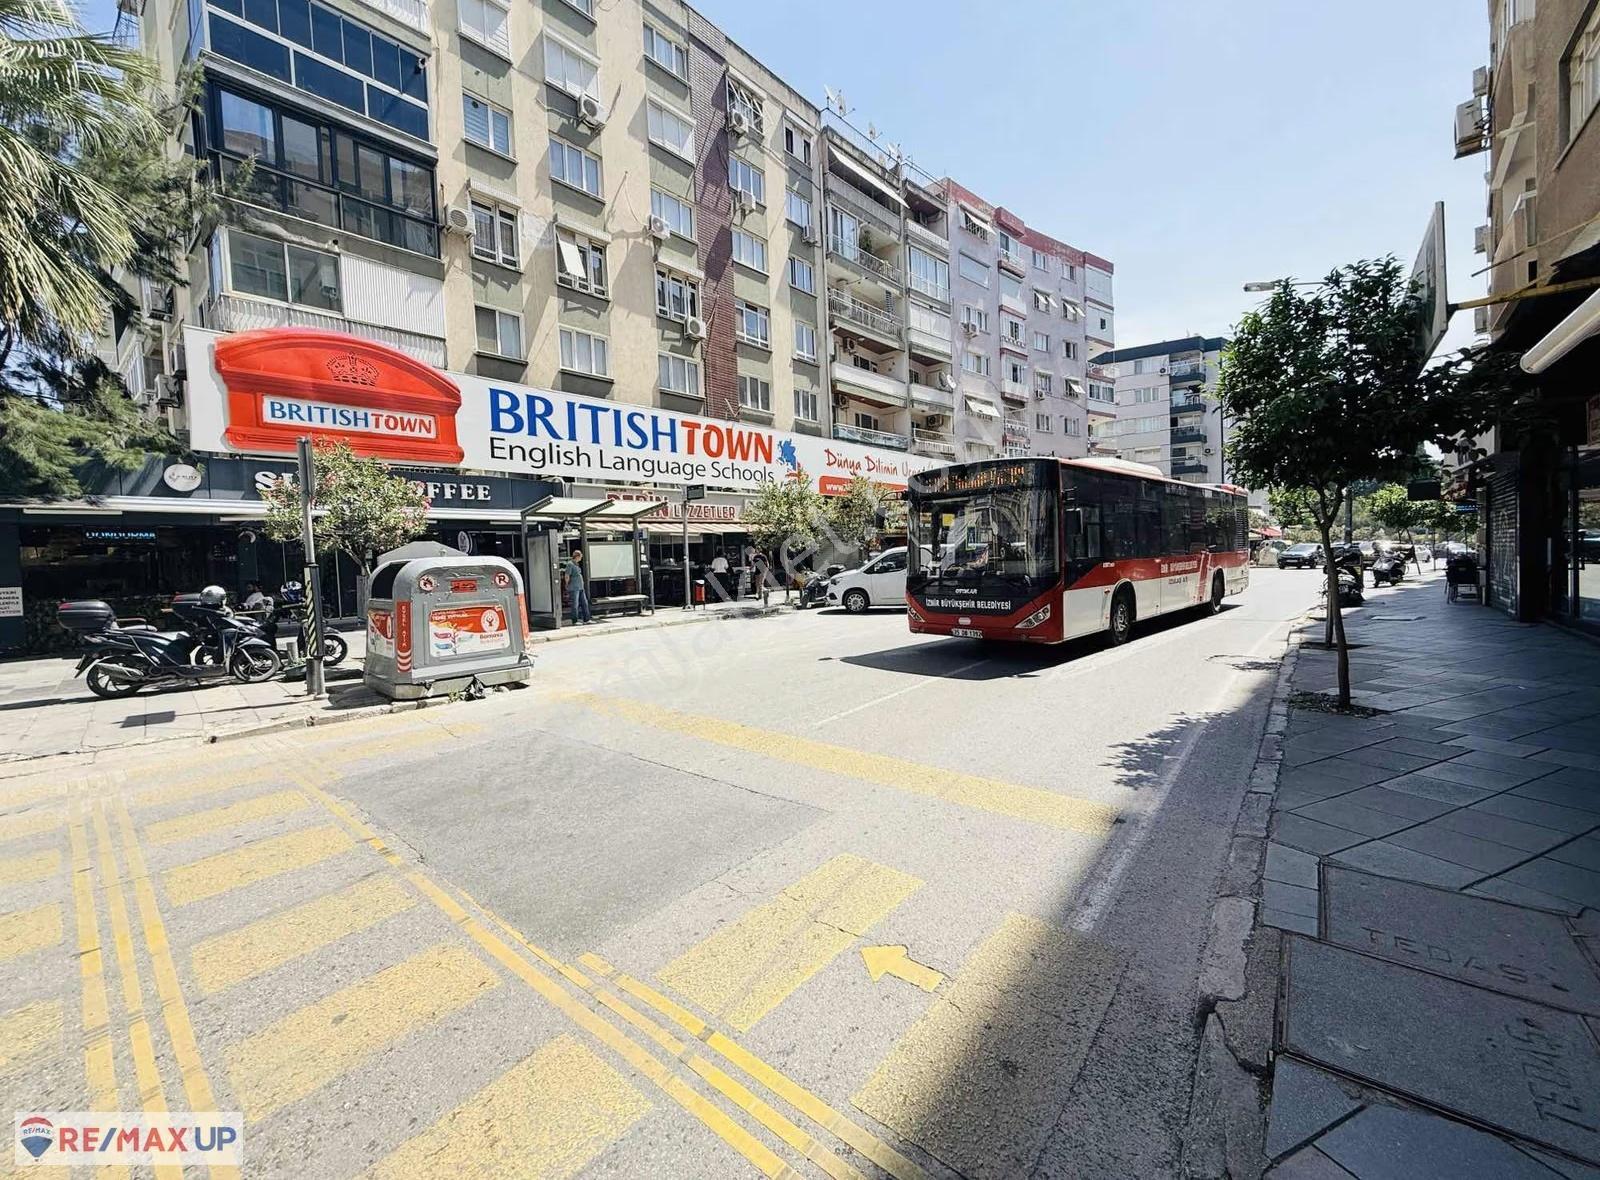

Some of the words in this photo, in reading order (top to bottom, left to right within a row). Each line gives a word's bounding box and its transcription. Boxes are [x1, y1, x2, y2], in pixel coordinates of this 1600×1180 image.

[269, 400, 433, 438] BRITISHTOWN
[488, 387, 774, 464] BRITISHTOWN
[489, 436, 592, 470] English
[599, 446, 707, 483] Language
[710, 460, 775, 484] Schools
[823, 447, 862, 476] Dünya
[864, 454, 898, 476] Dilimin
[673, 504, 736, 519] LZZETLER
